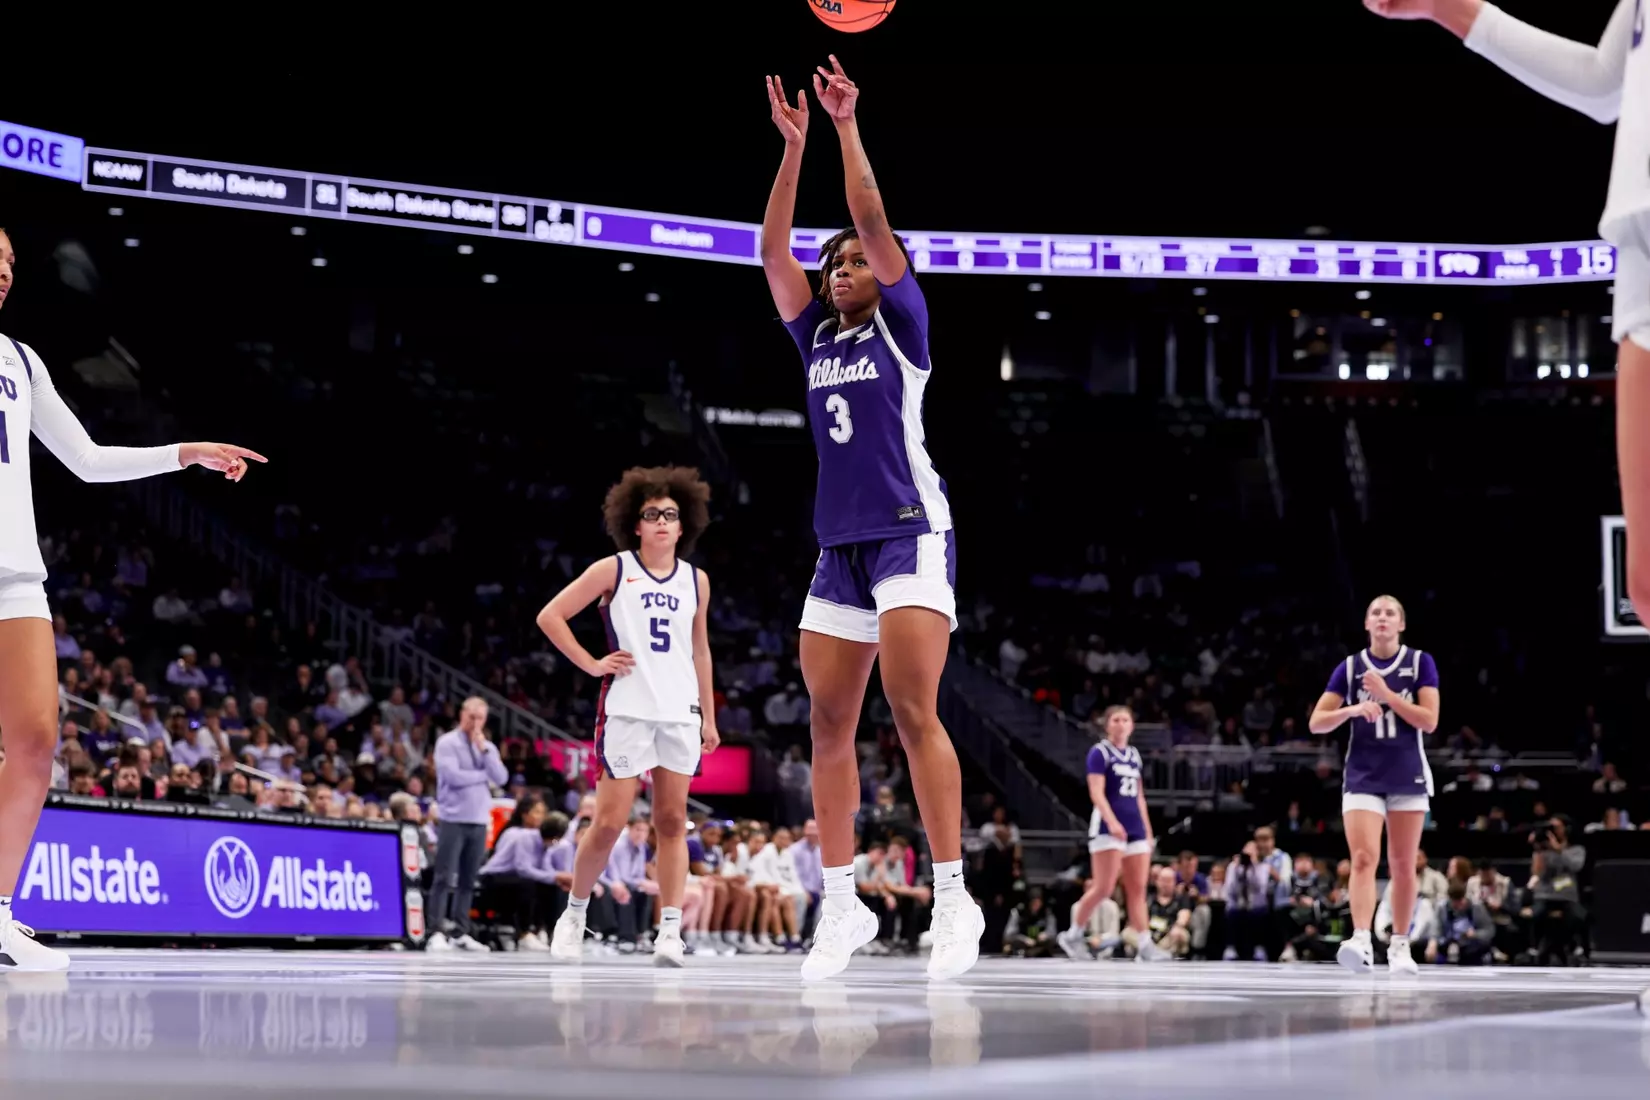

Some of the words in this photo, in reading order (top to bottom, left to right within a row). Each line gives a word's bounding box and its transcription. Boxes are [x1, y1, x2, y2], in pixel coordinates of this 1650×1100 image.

[2, 133, 64, 168] ORE
[172, 167, 225, 192] South
[226, 173, 287, 200] Dakota
[346, 187, 395, 212] South
[395, 192, 451, 218] Dakota
[451, 199, 497, 223] State
[0, 374, 18, 402] U
[808, 355, 880, 392] Wildcats
[825, 393, 854, 444] 3
[640, 592, 680, 612] TCU
[649, 617, 671, 653] 5
[1376, 710, 1396, 739] 11
[19, 841, 160, 905] Allstate
[262, 855, 373, 912] Allstate
